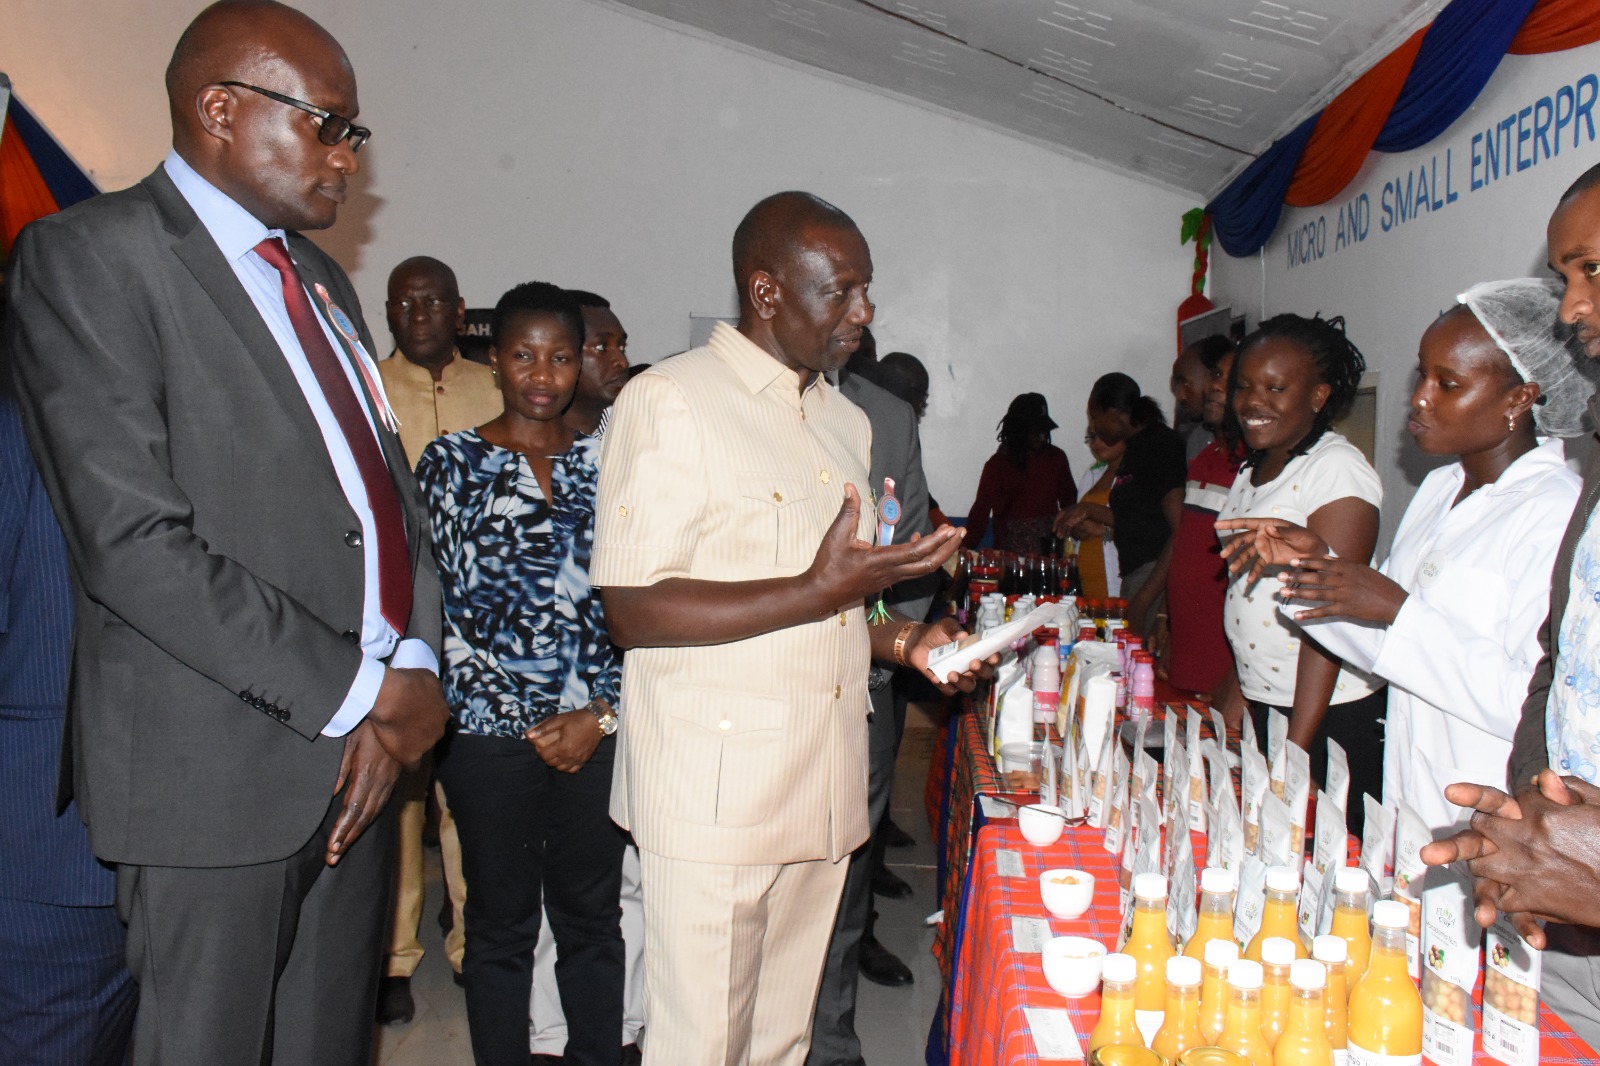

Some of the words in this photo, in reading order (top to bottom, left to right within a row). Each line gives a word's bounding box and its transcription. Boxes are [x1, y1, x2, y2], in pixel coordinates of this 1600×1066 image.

[1287, 215, 1326, 270] MICRO
[1335, 192, 1370, 253] AND
[1381, 147, 1459, 233] SMALL
[1471, 73, 1600, 192] ENTERPR
